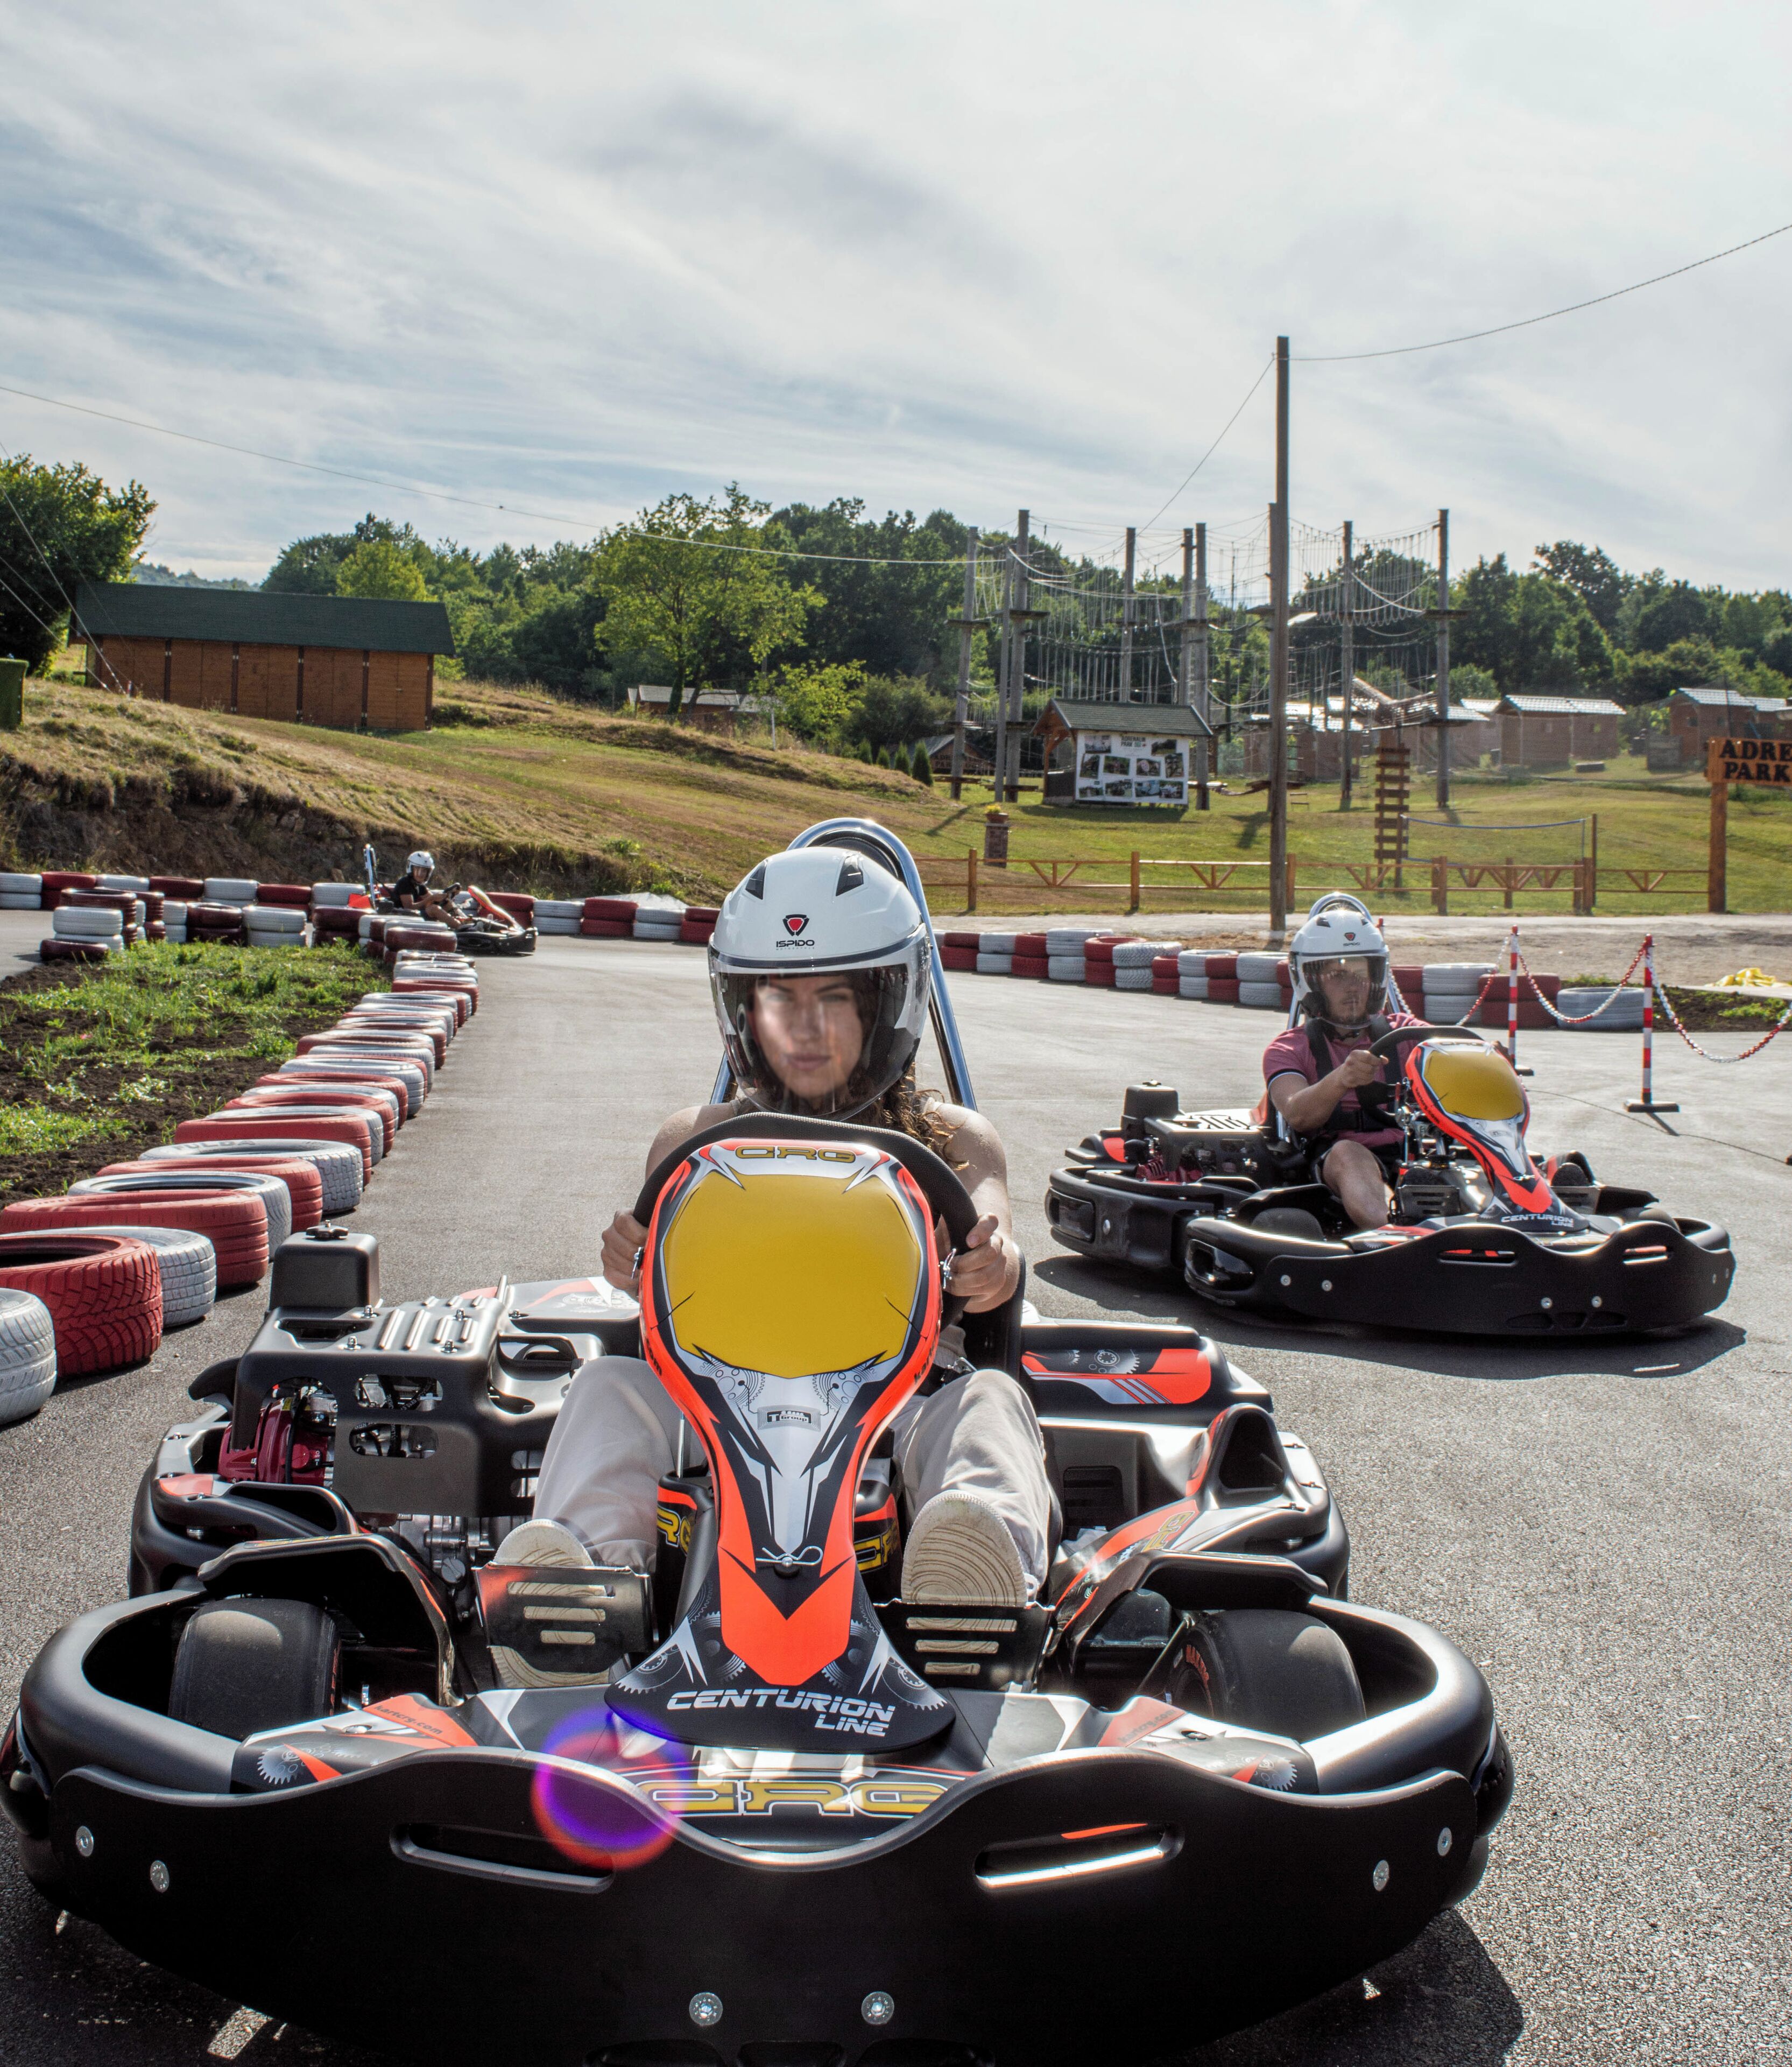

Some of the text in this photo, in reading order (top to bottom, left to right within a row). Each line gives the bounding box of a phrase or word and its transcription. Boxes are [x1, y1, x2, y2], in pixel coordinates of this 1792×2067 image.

[1719, 739, 1792, 762] ADRE
[1723, 761, 1791, 782] PARK
[776, 939, 815, 947] ISPIDO
[735, 1145, 856, 1164] CRG
[1500, 1213, 1574, 1224] CENTURION
[666, 1689, 896, 1723] CENTURION
[373, 1705, 443, 1735] kartcrg.com
[814, 1714, 890, 1737] LINE
